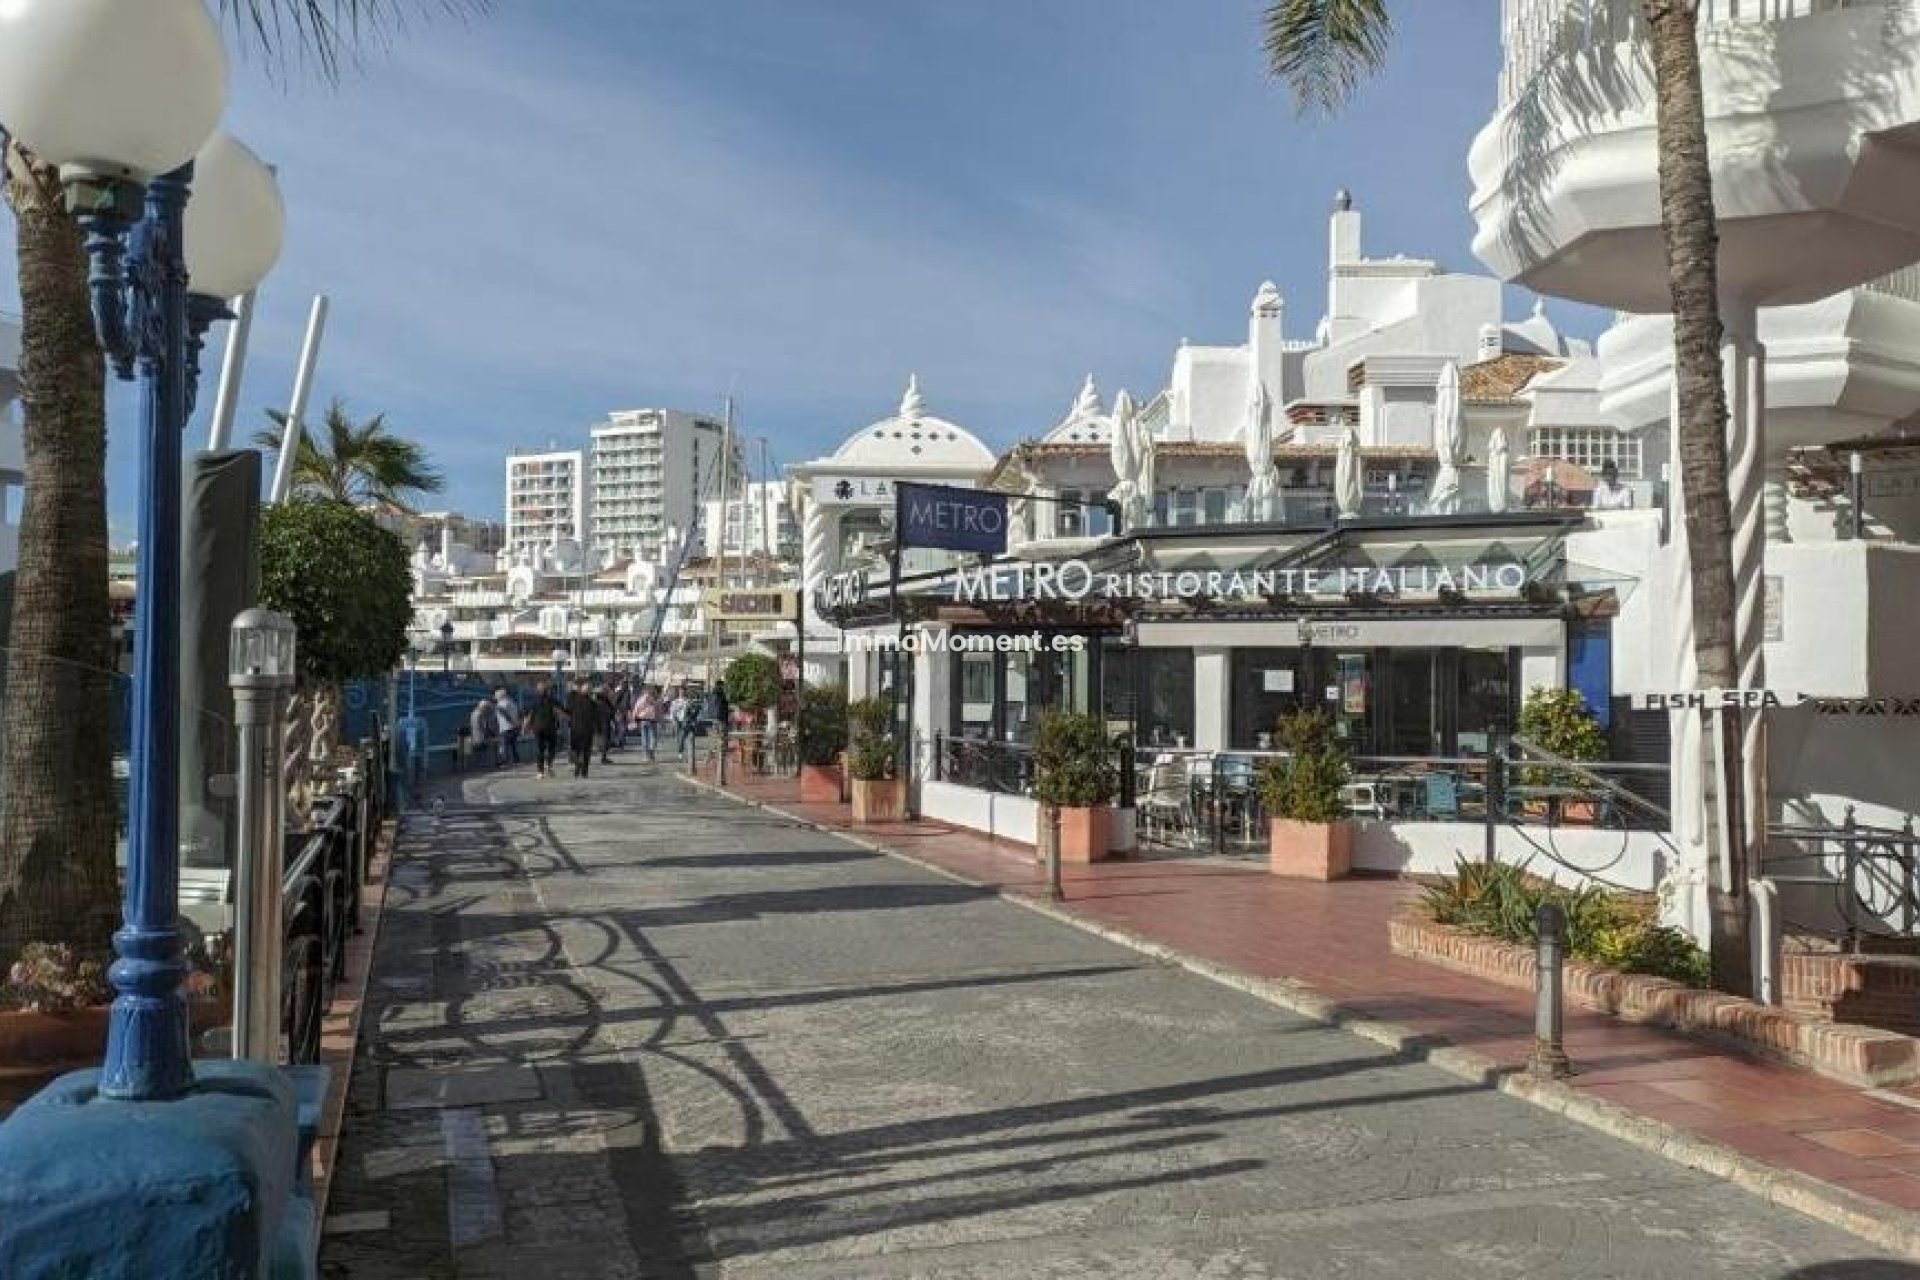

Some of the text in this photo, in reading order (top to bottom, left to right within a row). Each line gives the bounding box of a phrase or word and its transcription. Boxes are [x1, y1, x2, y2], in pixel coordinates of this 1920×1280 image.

[909, 500, 1001, 534] METRO
[953, 560, 1526, 603] METRO RISTORANTE ITALIANO
[1646, 690, 1781, 708] FISH SPA
